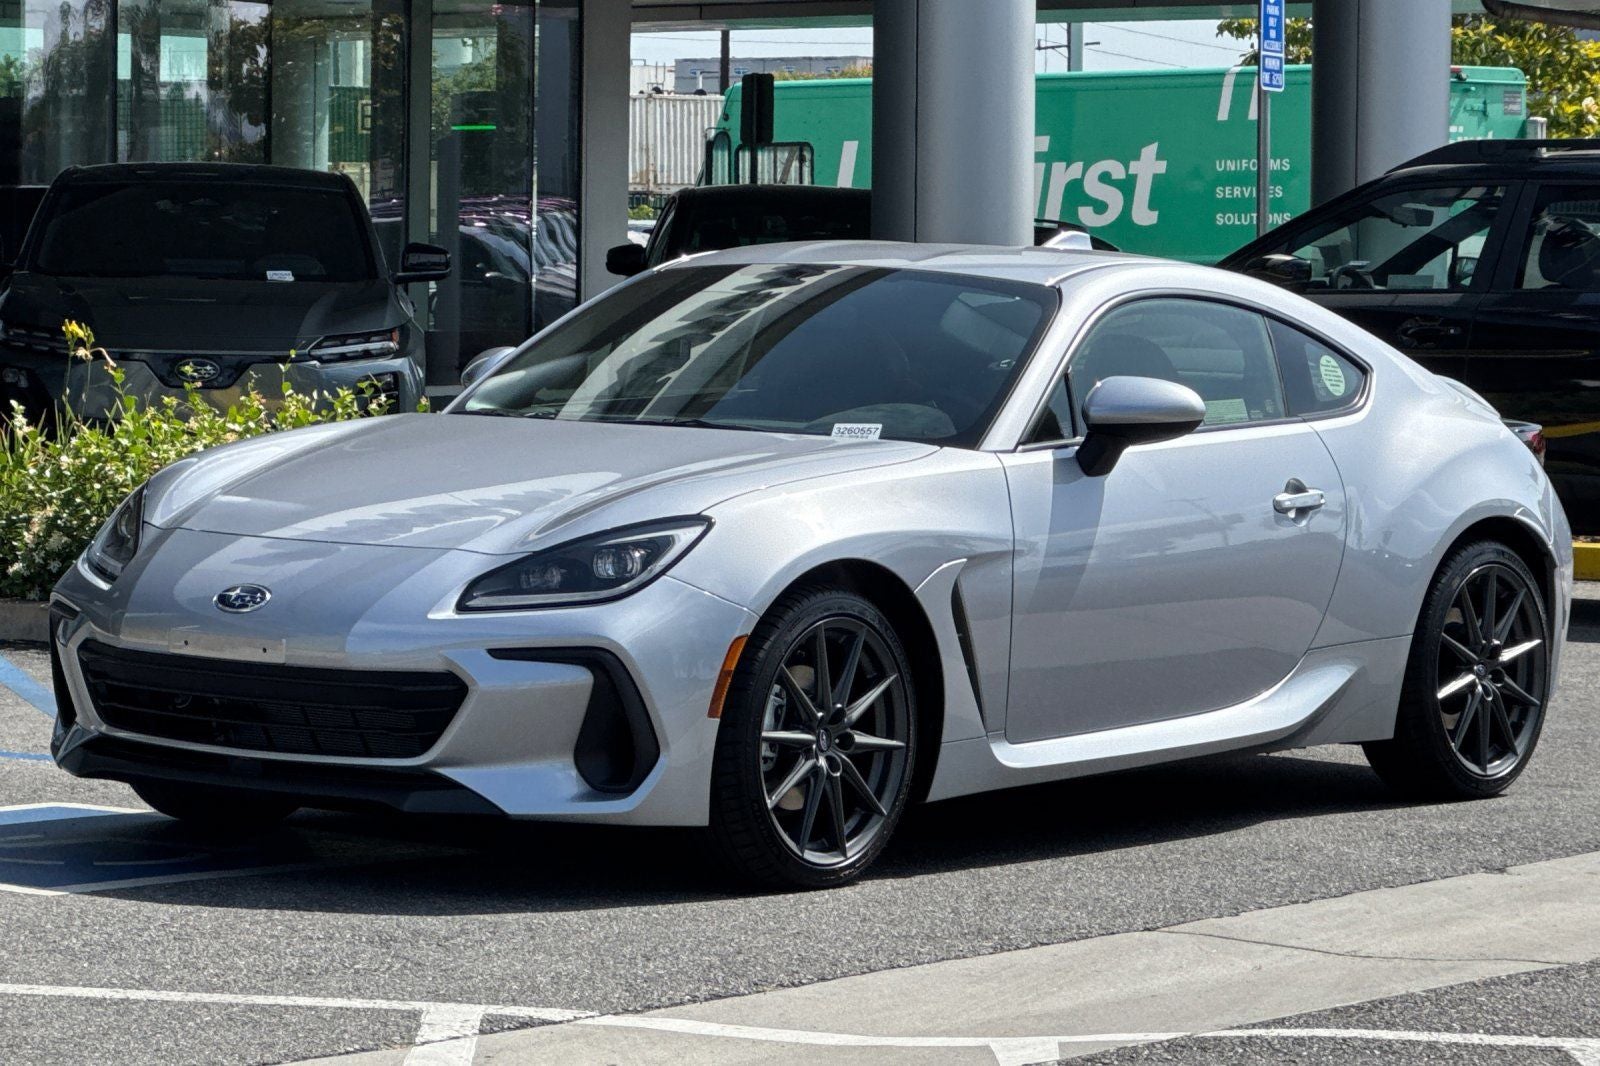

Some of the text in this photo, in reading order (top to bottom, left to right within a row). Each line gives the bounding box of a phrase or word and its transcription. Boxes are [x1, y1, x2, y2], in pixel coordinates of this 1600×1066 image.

[1215, 158, 1291, 172] UNIFOMS
[1034, 135, 1167, 227] irst
[1215, 185, 1284, 199] SERVIES
[1215, 212, 1292, 226] SOLUTNS
